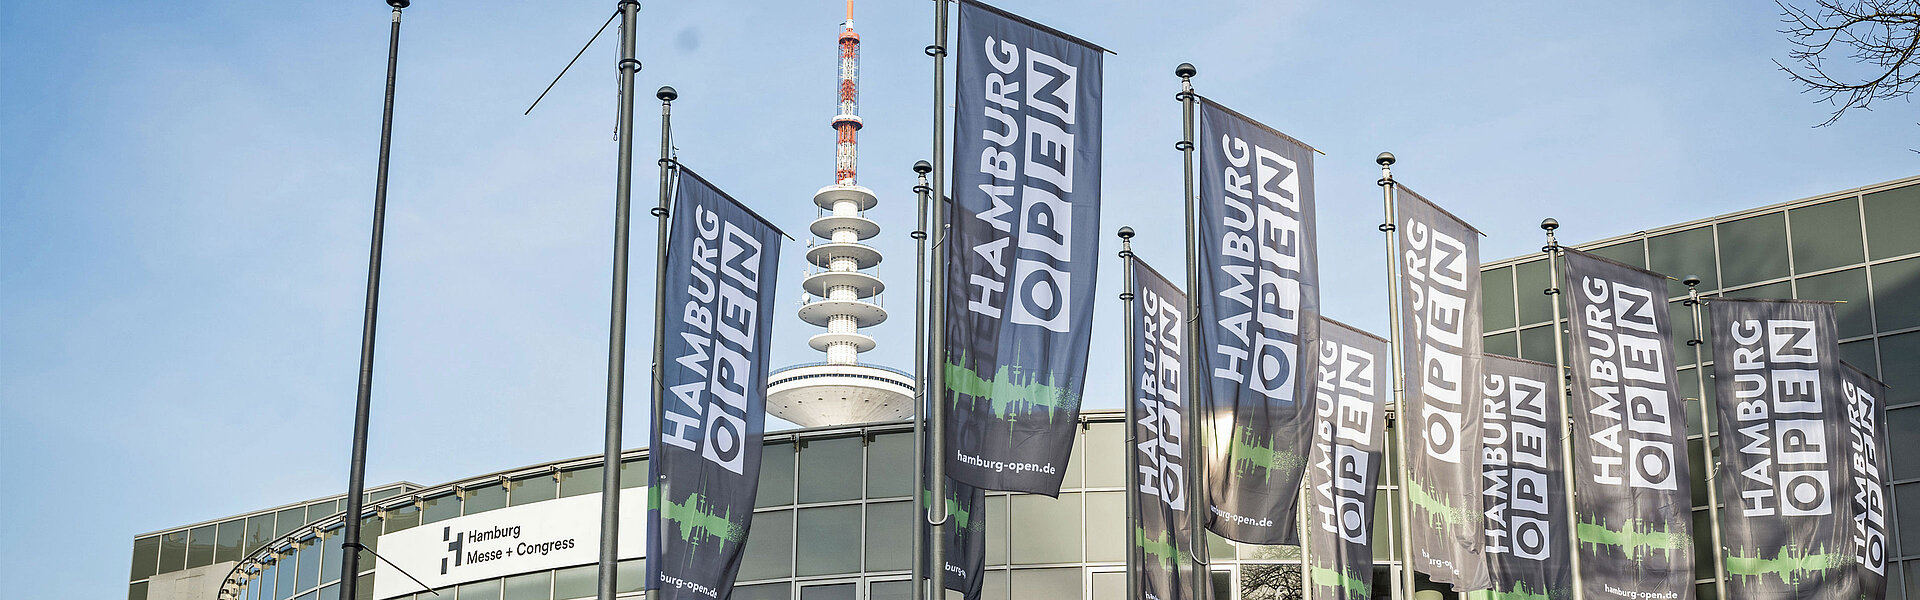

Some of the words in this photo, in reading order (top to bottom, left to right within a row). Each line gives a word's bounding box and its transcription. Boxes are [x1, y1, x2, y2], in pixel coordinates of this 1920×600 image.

[968, 35, 1020, 319] HAMBURG
[1010, 48, 1078, 333] OPEN
[1214, 133, 1255, 384] HAMBURG
[1249, 144, 1300, 401] OPEN
[661, 204, 721, 452] HAMBURG
[702, 220, 762, 475] OPEN
[1137, 286, 1160, 497] HAMBURG
[1157, 297, 1185, 511] OPEN
[1424, 228, 1468, 463] OPEN
[1582, 275, 1624, 485] HAMBURG
[1612, 281, 1678, 491] OPEN
[1731, 318, 1775, 518] HAMBURG
[1767, 319, 1832, 517] OPEN
[468, 525, 521, 543] Hamburg
[957, 449, 1056, 475] hamburg-open.de
[1315, 339, 1340, 534] HAMBURG
[1335, 343, 1374, 546] OPEN
[1482, 373, 1510, 554] HAMBURG
[1509, 375, 1550, 561] OPEN
[1856, 386, 1885, 577] OPEN
[466, 550, 503, 565] Messe
[505, 547, 513, 557] +
[516, 538, 575, 556] Congress
[660, 571, 718, 599] burg-open.de
[1604, 583, 1679, 600] hamburg-open.de
